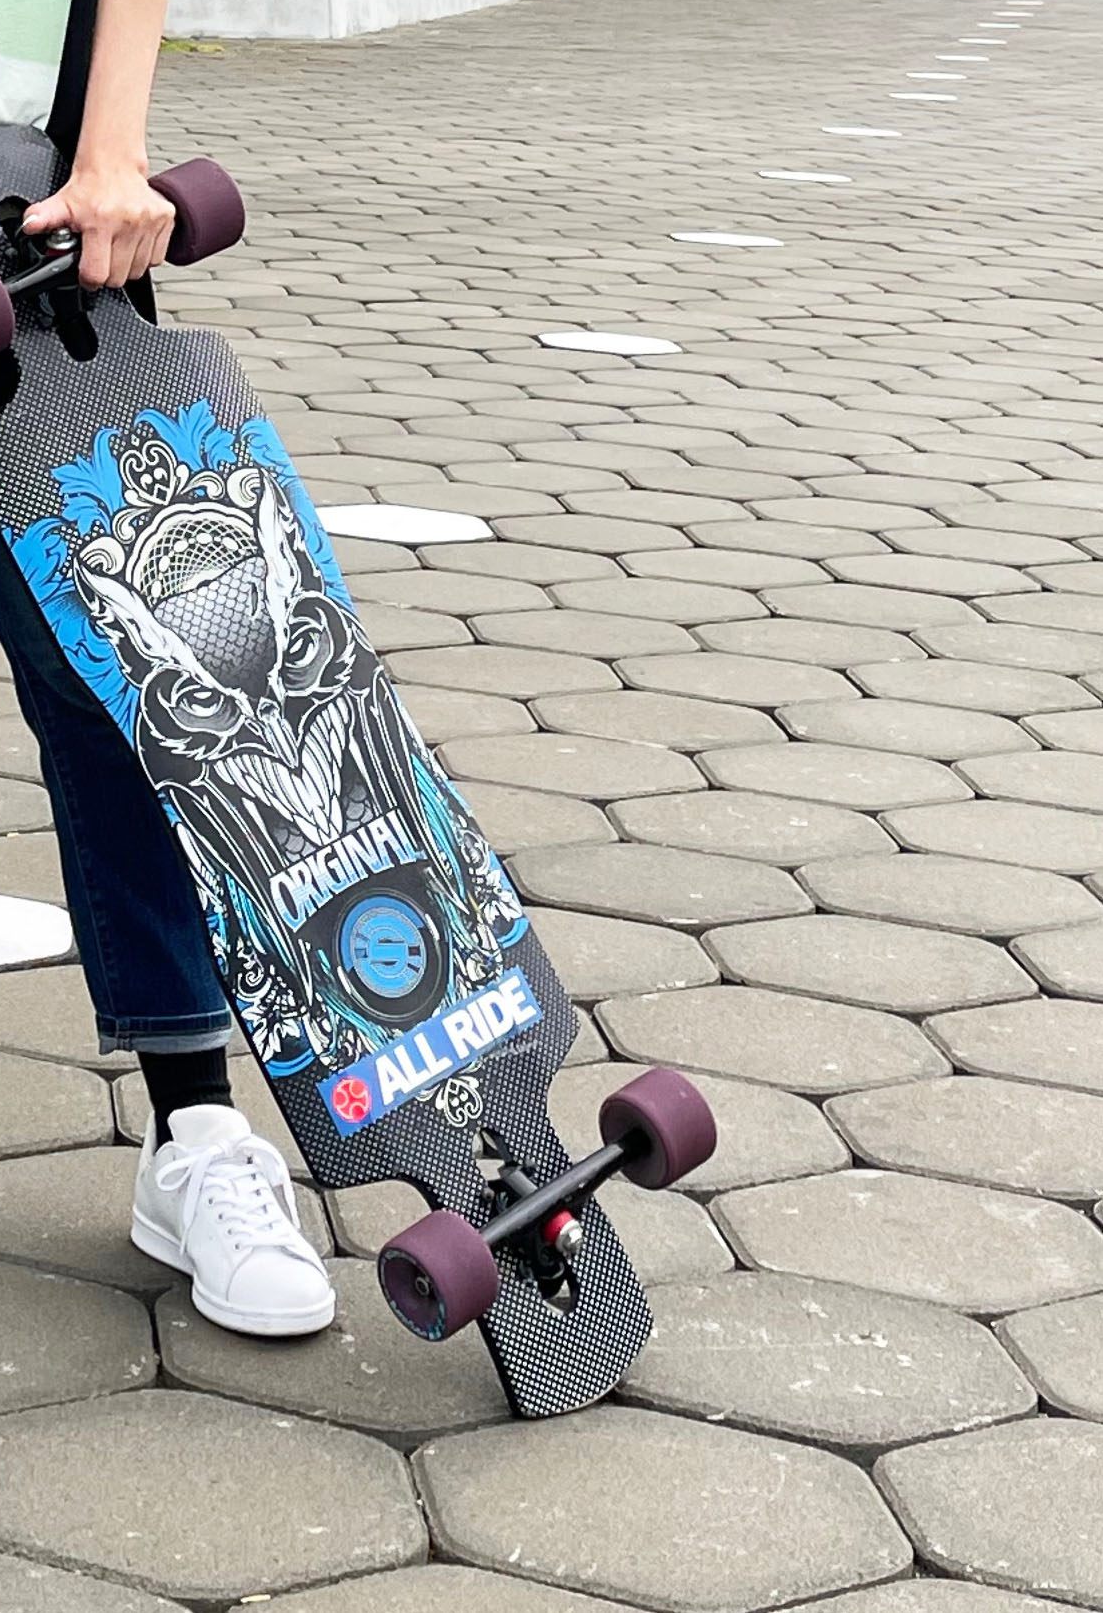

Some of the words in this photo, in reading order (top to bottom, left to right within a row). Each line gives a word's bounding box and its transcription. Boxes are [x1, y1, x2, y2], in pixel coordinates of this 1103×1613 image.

[269, 808, 428, 933] ORIGINAL
[375, 1032, 453, 1106] ALL
[442, 975, 537, 1060] RIDE
